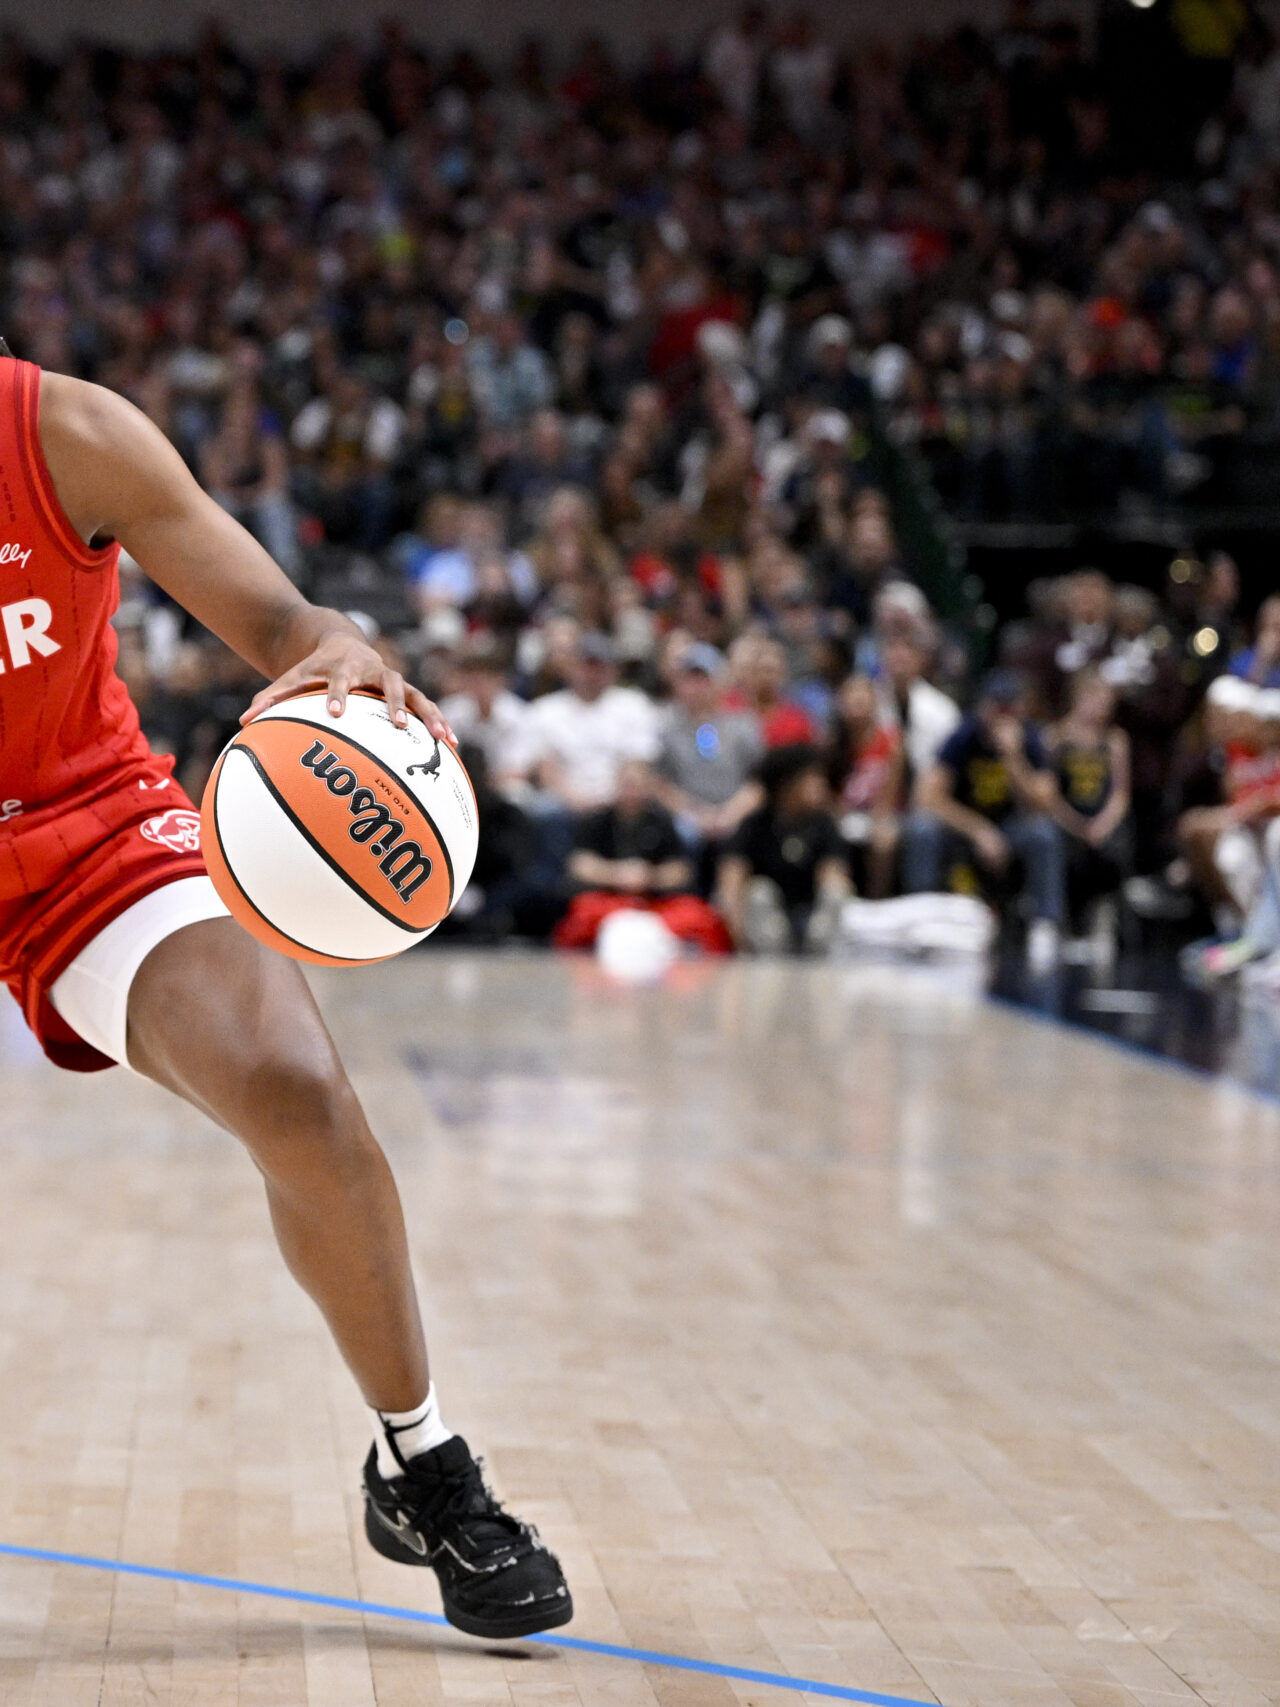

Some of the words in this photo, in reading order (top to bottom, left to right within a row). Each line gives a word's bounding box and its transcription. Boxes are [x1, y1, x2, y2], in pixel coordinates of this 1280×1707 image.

[374, 778, 393, 797] NXT
[392, 796, 411, 816] EVO
[300, 739, 432, 904] Wilson
